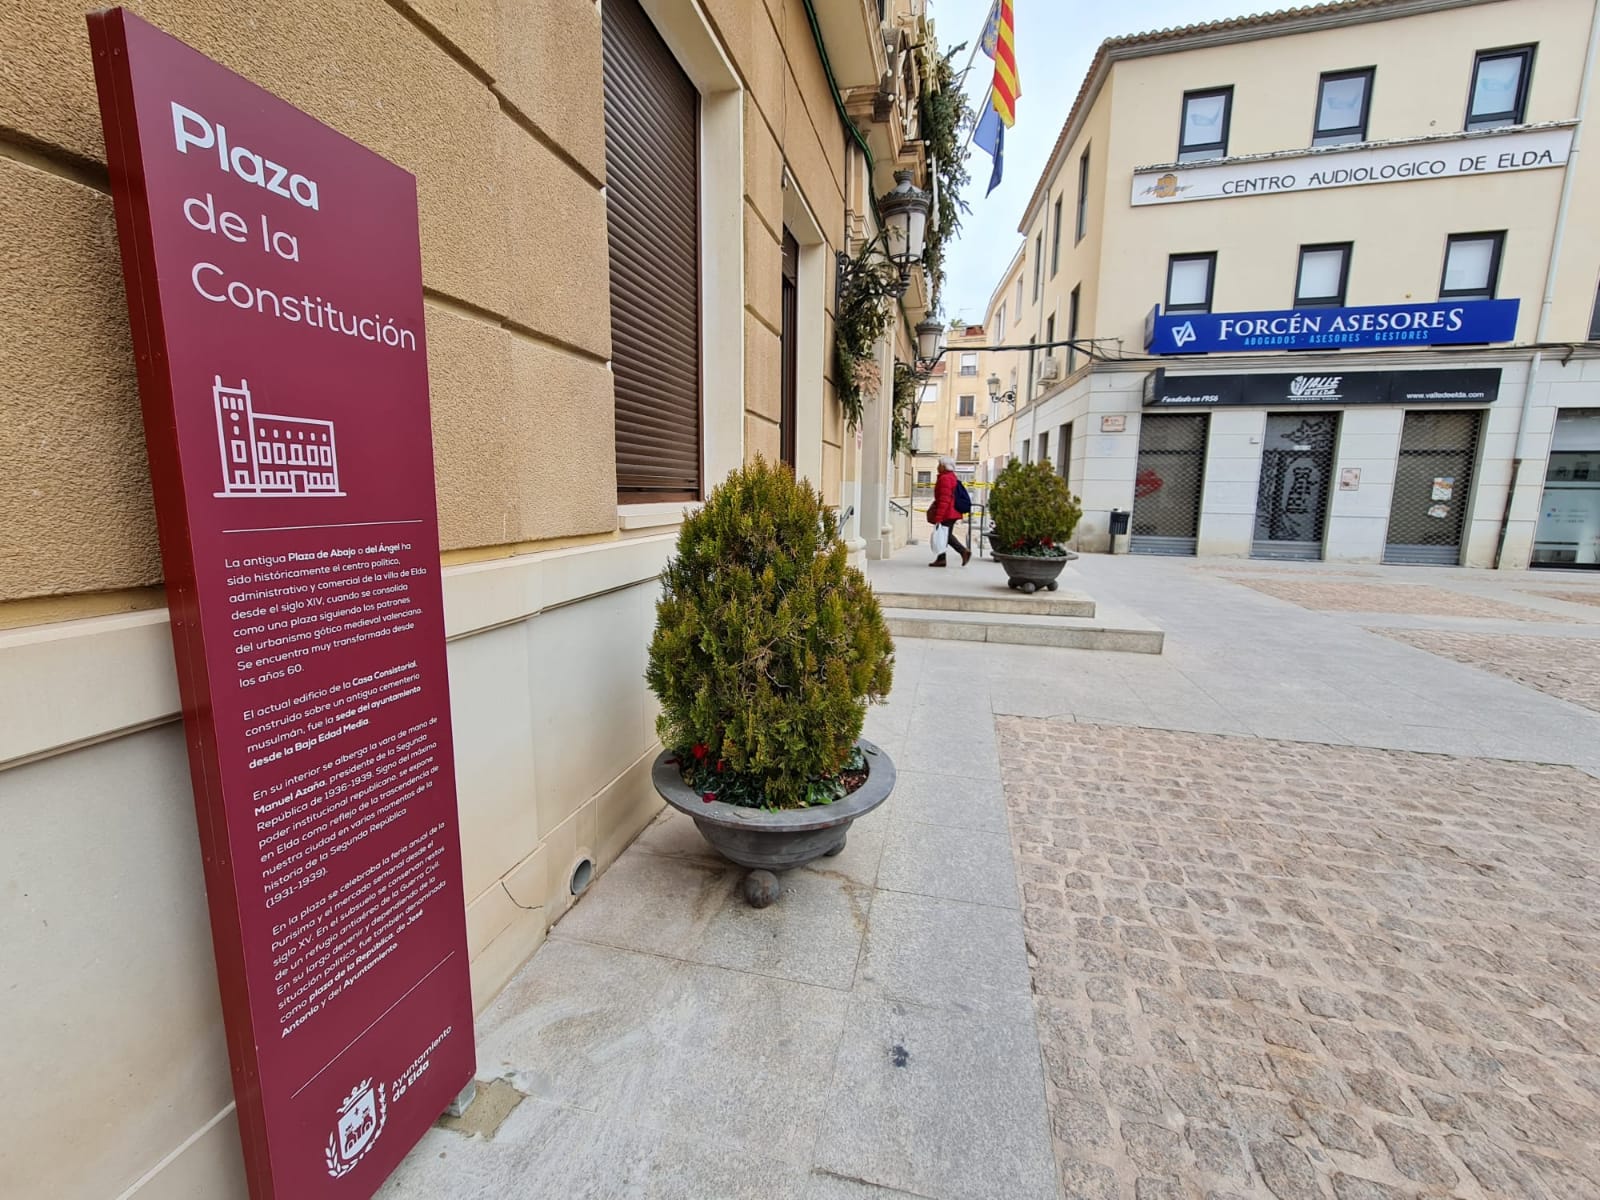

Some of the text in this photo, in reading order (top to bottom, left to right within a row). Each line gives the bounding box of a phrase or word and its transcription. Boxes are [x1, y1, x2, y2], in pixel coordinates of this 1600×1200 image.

[170, 101, 318, 210] Plaza
[1222, 175, 1296, 194] CENTRO
[1308, 160, 1446, 186] AUDIOLOGICO
[1459, 156, 1487, 172] DE
[1498, 150, 1553, 168] ELDA
[183, 193, 299, 262] de la
[192, 262, 416, 351] Constitución
[1218, 308, 1464, 340] FORCÉN ASESORES
[1244, 330, 1429, 345] ABOGADOS ASESORES GESTORES
[224, 542, 400, 568] La antigua Plaza Abajo del Ángel
[226, 574, 251, 585] sido
[341, 561, 369, 571] centro
[228, 567, 426, 602] administrativo comercial villa Elda
[231, 606, 266, 620] desde
[280, 600, 304, 613] siglo
[326, 591, 359, 603] cuando
[232, 597, 410, 637] como una plaza siguiendo patrones
[235, 641, 253, 654] del
[255, 631, 311, 649] urbanismo
[313, 625, 342, 639] gótico
[343, 615, 381, 629] medieval
[236, 660, 253, 671] Se
[255, 647, 309, 666] encuentra
[310, 642, 331, 653] muy
[391, 622, 414, 633] desde
[239, 663, 304, 687] los años 60.
[243, 709, 254, 720] El
[256, 698, 291, 716] actual
[292, 688, 327, 704] edificio
[351, 674, 373, 686] Casa
[304, 703, 331, 717] sobre
[345, 687, 377, 702] antiguo
[378, 673, 420, 691] cementerio
[247, 686, 421, 752] musulmán, fue sede del ayuntamiento
[248, 751, 282, 768] desde
[294, 737, 317, 751] Baja
[317, 726, 342, 742] Edad
[252, 721, 427, 800] En su interior alberga vara mano
[254, 792, 293, 816] Manuel
[329, 757, 374, 784] presidente
[395, 734, 427, 752] Segunda
[256, 802, 308, 831] República
[309, 796, 322, 806] de
[375, 760, 397, 775] Signo
[397, 753, 409, 764] del
[258, 826, 290, 850] poder
[292, 796, 348, 830] institucional
[260, 770, 429, 862] en Elda como reflejo trascendencia
[262, 790, 415, 877] nuestra ciudad varios momentos
[263, 808, 406, 893] historia de Segunda República
[272, 923, 286, 935] En
[300, 897, 326, 920] plaza
[327, 889, 338, 900] se
[339, 862, 381, 892] celebraba
[408, 831, 428, 848] anual
[334, 882, 371, 910] mercado
[372, 859, 404, 884] semanal
[405, 846, 426, 863] desde
[272, 947, 296, 966] siglo
[298, 933, 314, 949] XV.
[315, 925, 328, 937] En
[339, 892, 376, 920] subsuelo
[387, 860, 424, 887] conservan
[274, 968, 288, 980] de
[290, 957, 303, 969] un
[305, 932, 338, 959] refugio
[399, 872, 424, 891] Guerra
[276, 888, 418, 995] En su largo devenir dependiendo
[278, 973, 322, 1009] situación
[358, 935, 372, 948] fue
[405, 880, 446, 913] denominada
[279, 999, 307, 1023] como
[308, 978, 333, 1003] plaza
[333, 969, 346, 981] de
[281, 1004, 319, 1038] Antonio
[327, 984, 341, 1000] del
[392, 1026, 452, 1092] Ayuntamiento
[393, 1060, 430, 1102] de Elda
